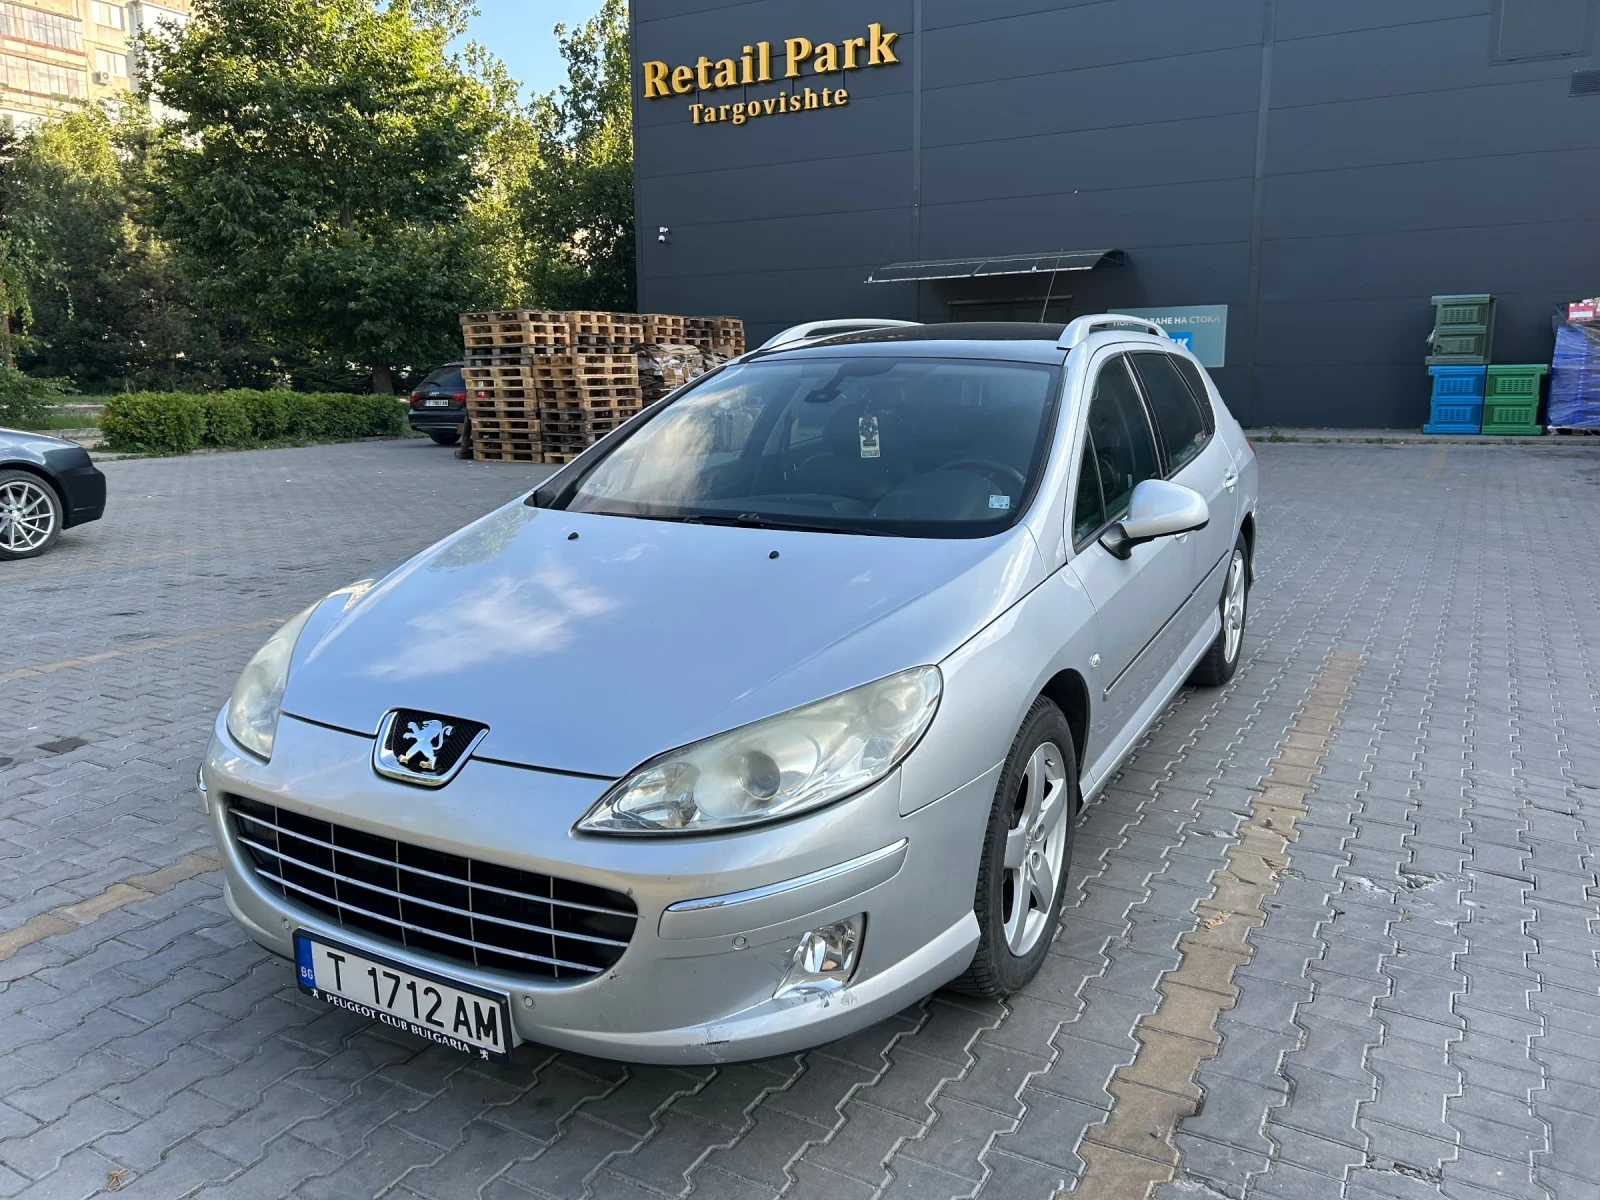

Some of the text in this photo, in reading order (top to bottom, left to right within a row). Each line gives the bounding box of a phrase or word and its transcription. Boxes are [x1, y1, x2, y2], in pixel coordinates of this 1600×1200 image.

[643, 22, 899, 98] Retail Park
[688, 87, 848, 125] Targovishte
[301, 965, 314, 980] BG
[327, 951, 499, 1047] T 1712 AM
[326, 993, 471, 1054] PEUGEOT CLUB BULGARIA
